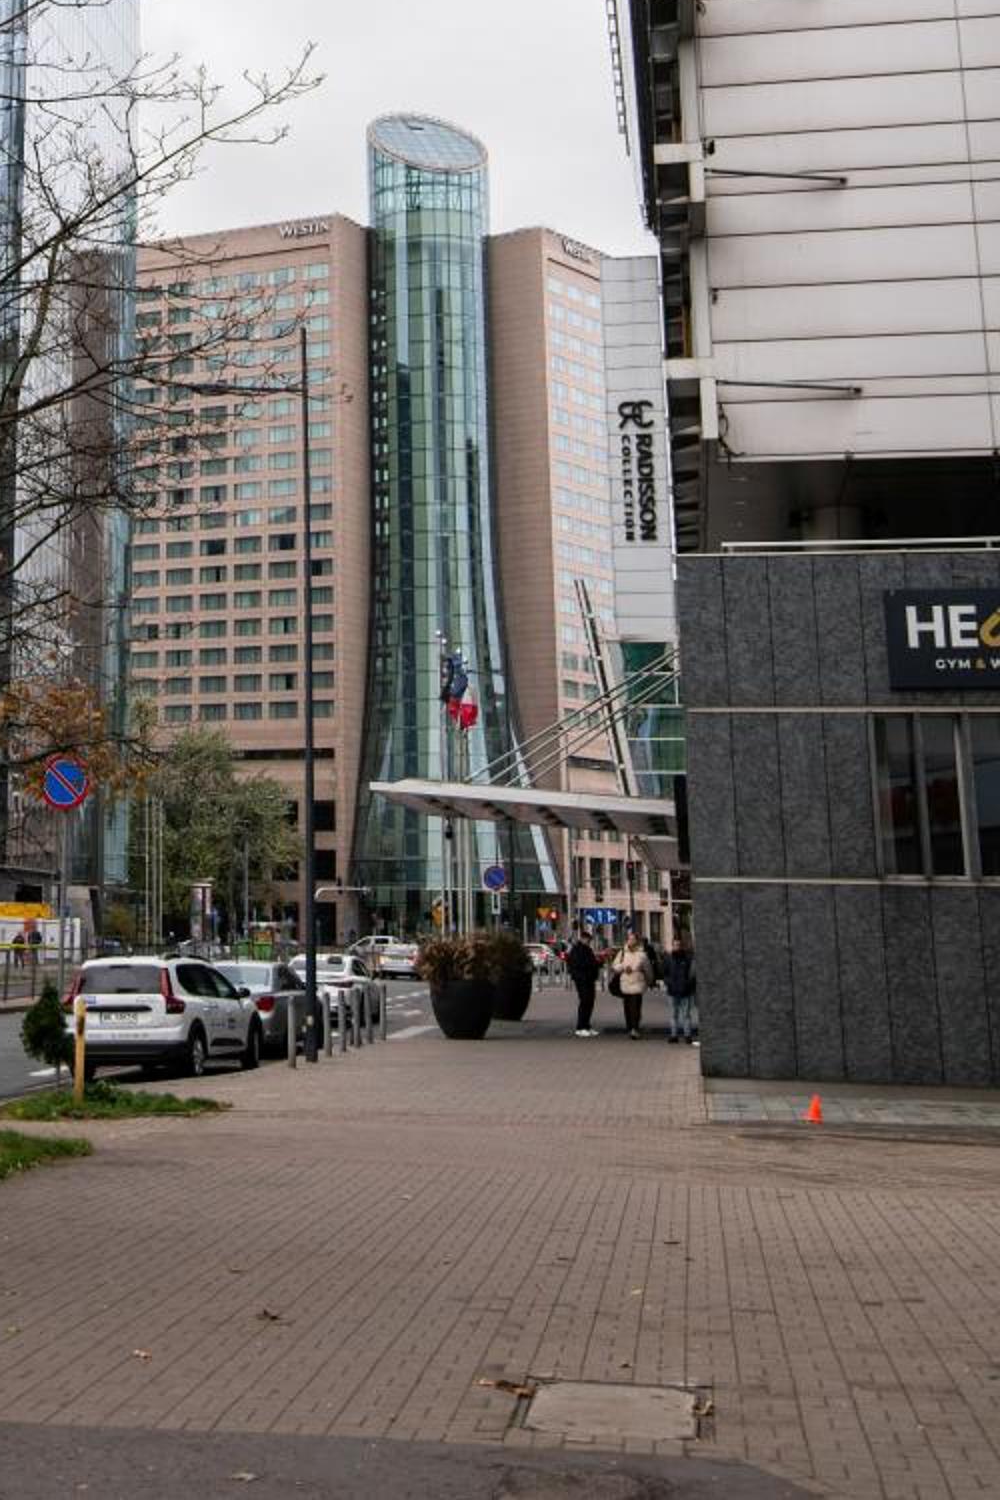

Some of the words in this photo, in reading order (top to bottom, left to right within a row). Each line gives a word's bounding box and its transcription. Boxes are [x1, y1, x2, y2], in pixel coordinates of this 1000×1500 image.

[279, 220, 330, 240] WESTIN
[621, 434, 635, 541] COLLECTION
[635, 433, 657, 541] RADISSON
[935, 659, 971, 669] GYM
